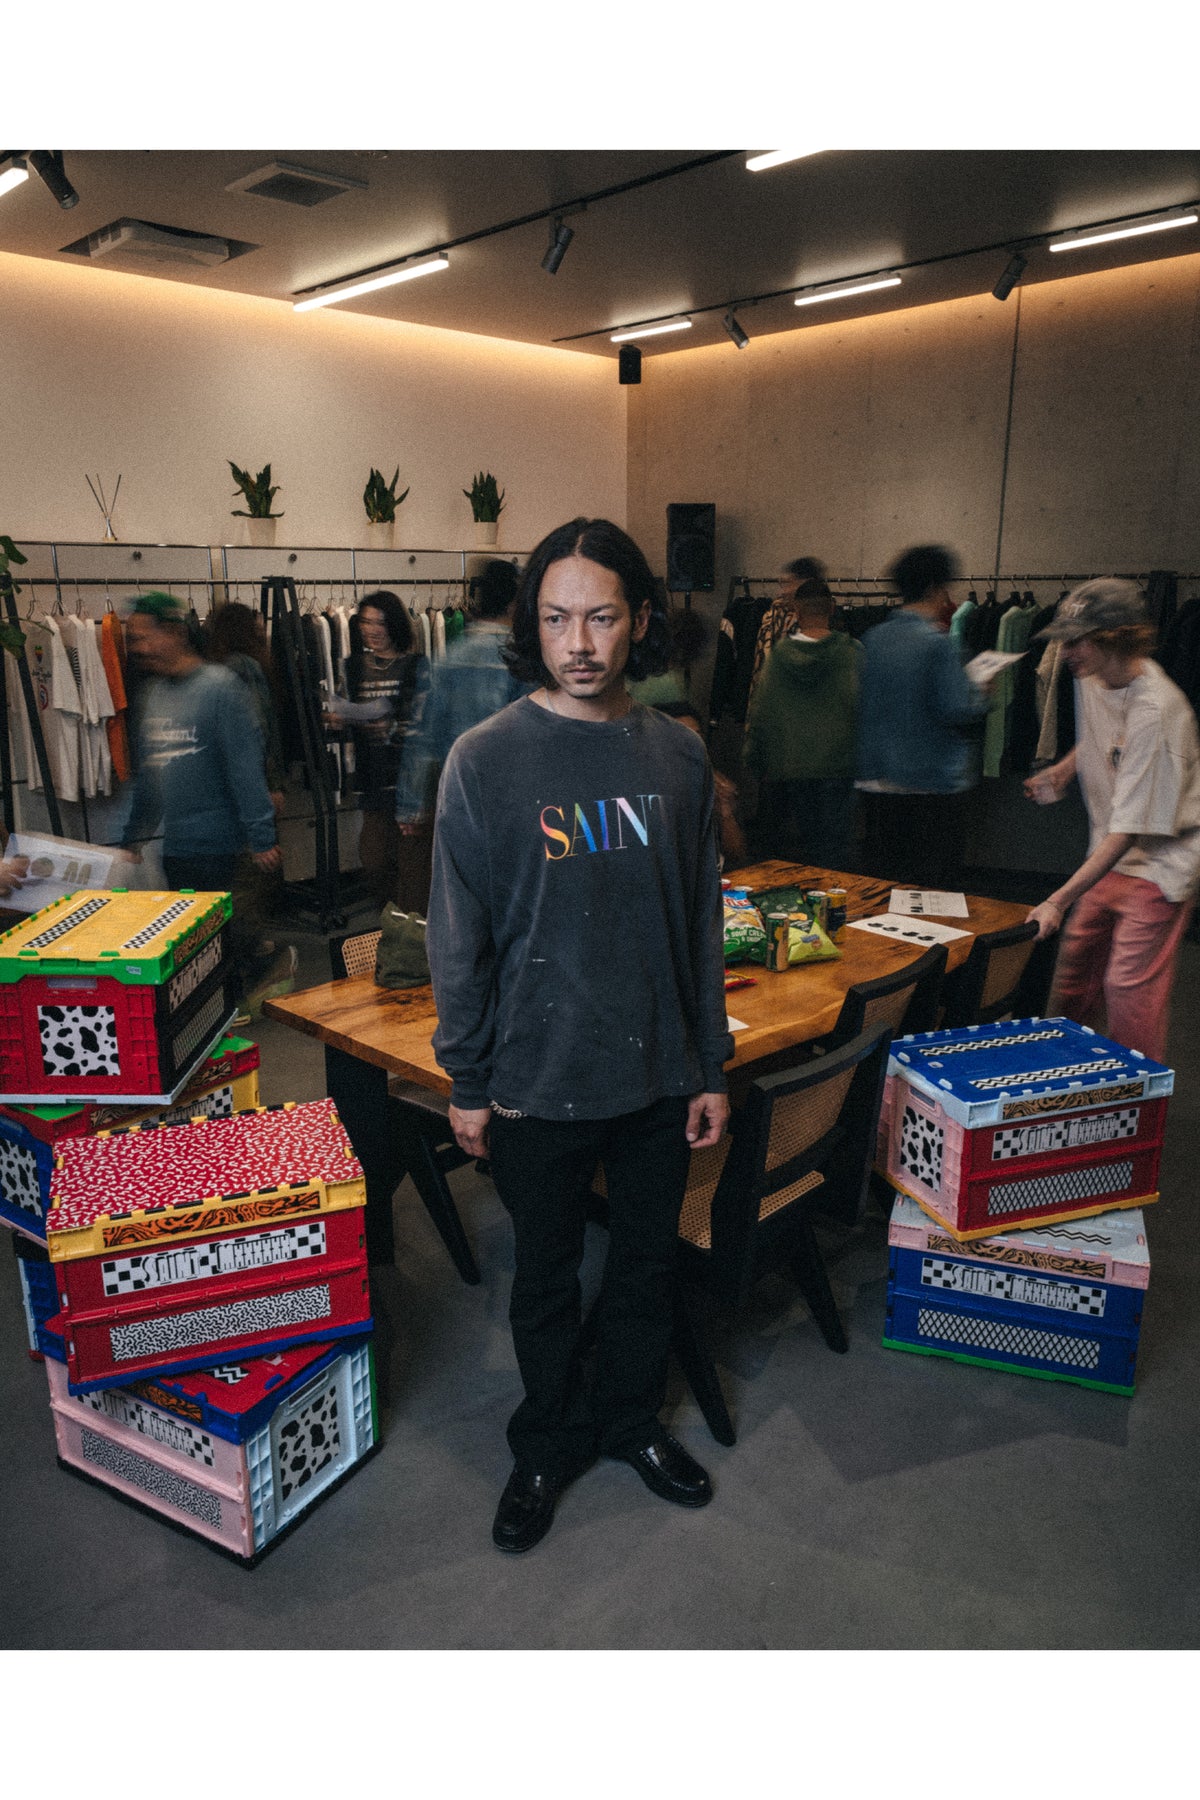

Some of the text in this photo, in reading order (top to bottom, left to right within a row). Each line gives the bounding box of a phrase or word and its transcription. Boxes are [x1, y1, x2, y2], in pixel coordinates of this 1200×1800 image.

[1018, 1126, 1056, 1153] SAINT
[142, 1250, 200, 1286] SAINT
[951, 1264, 998, 1295] SAINT
